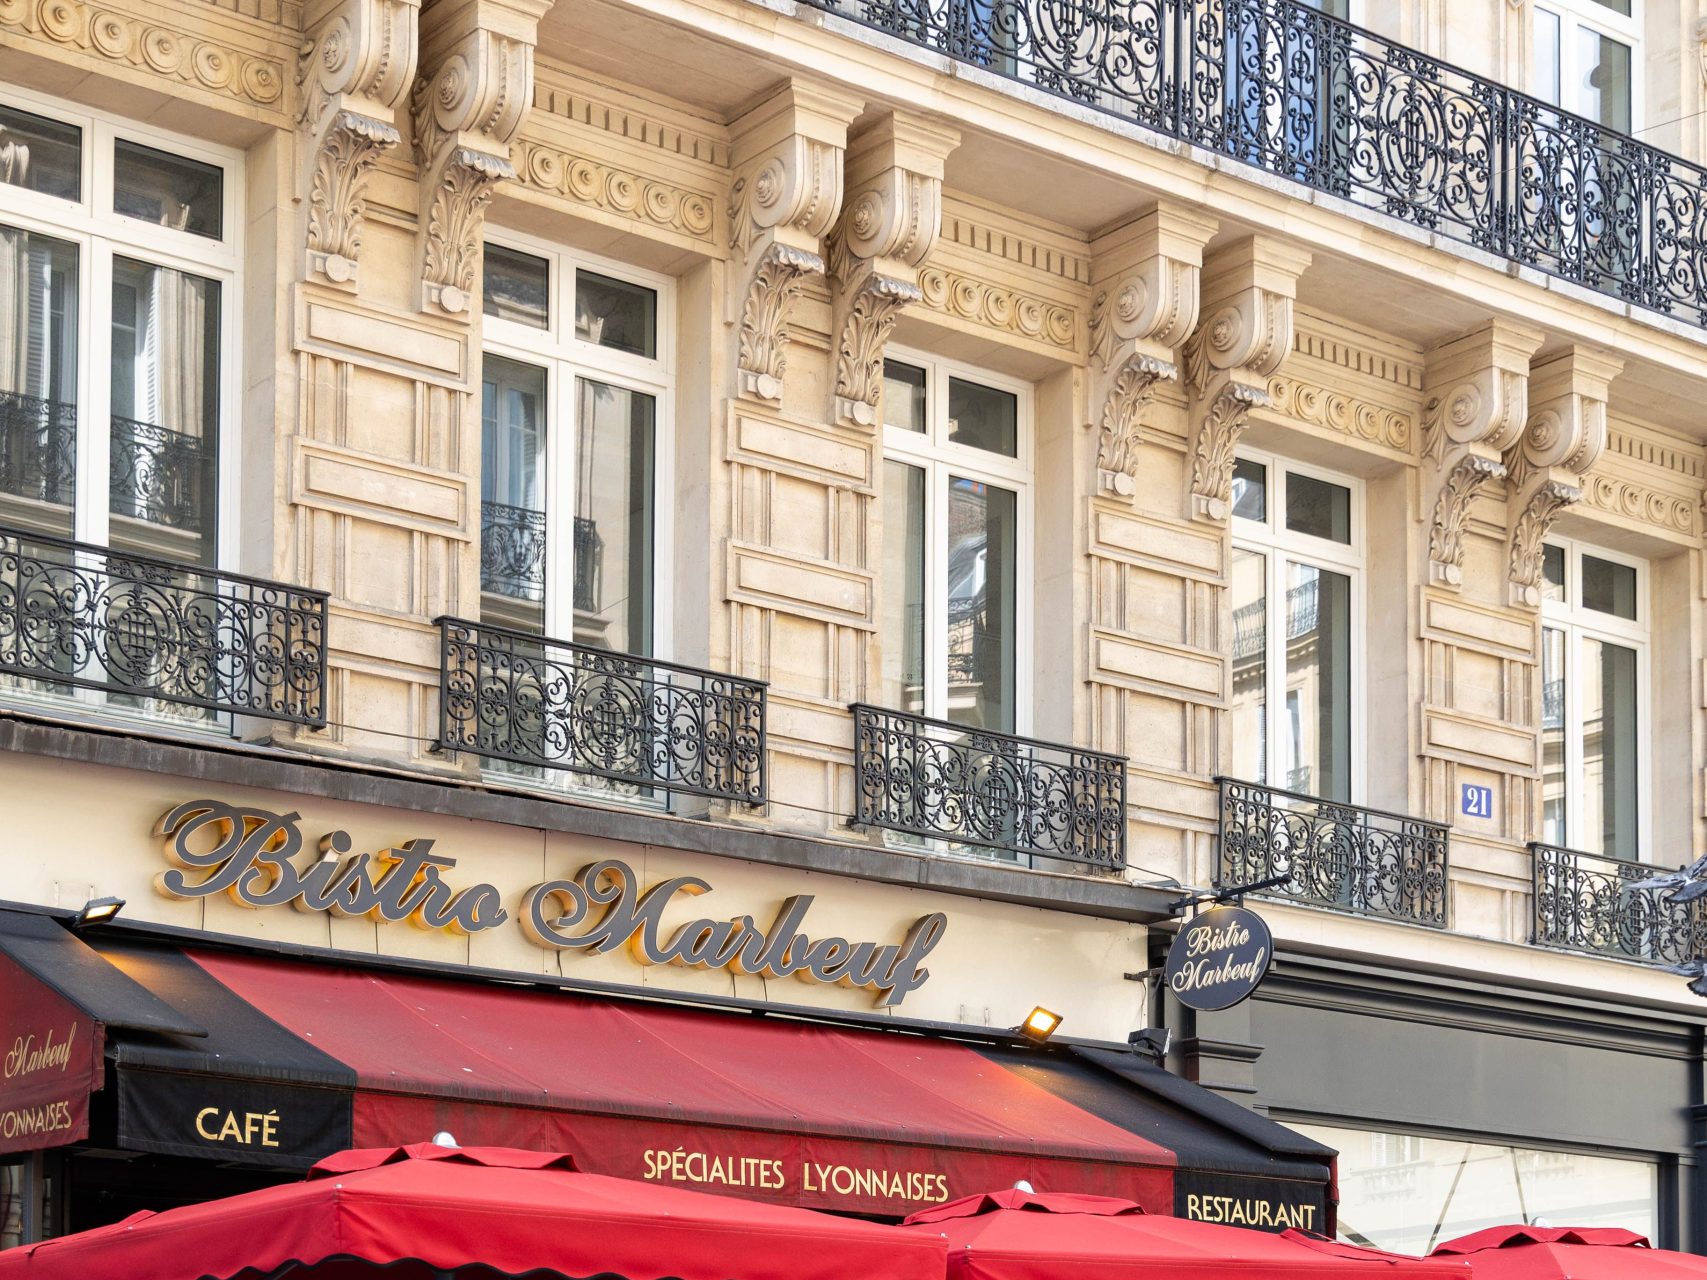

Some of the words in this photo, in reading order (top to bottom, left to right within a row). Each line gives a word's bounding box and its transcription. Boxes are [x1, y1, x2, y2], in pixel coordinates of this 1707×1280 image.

[1467, 787, 1487, 815] 21
[155, 800, 508, 935] Bistro
[520, 859, 948, 1008] Marbeuf
[1187, 920, 1250, 957] Bistro
[1172, 946, 1265, 992] Marbeuf
[4, 1021, 77, 1078] Marbeuf
[196, 1109, 280, 1147] CAFÉ
[643, 1147, 785, 1190] SPÉCIALITES
[803, 1163, 949, 1203] LYONNAISES
[1187, 1194, 1316, 1230] RESTAURANT
